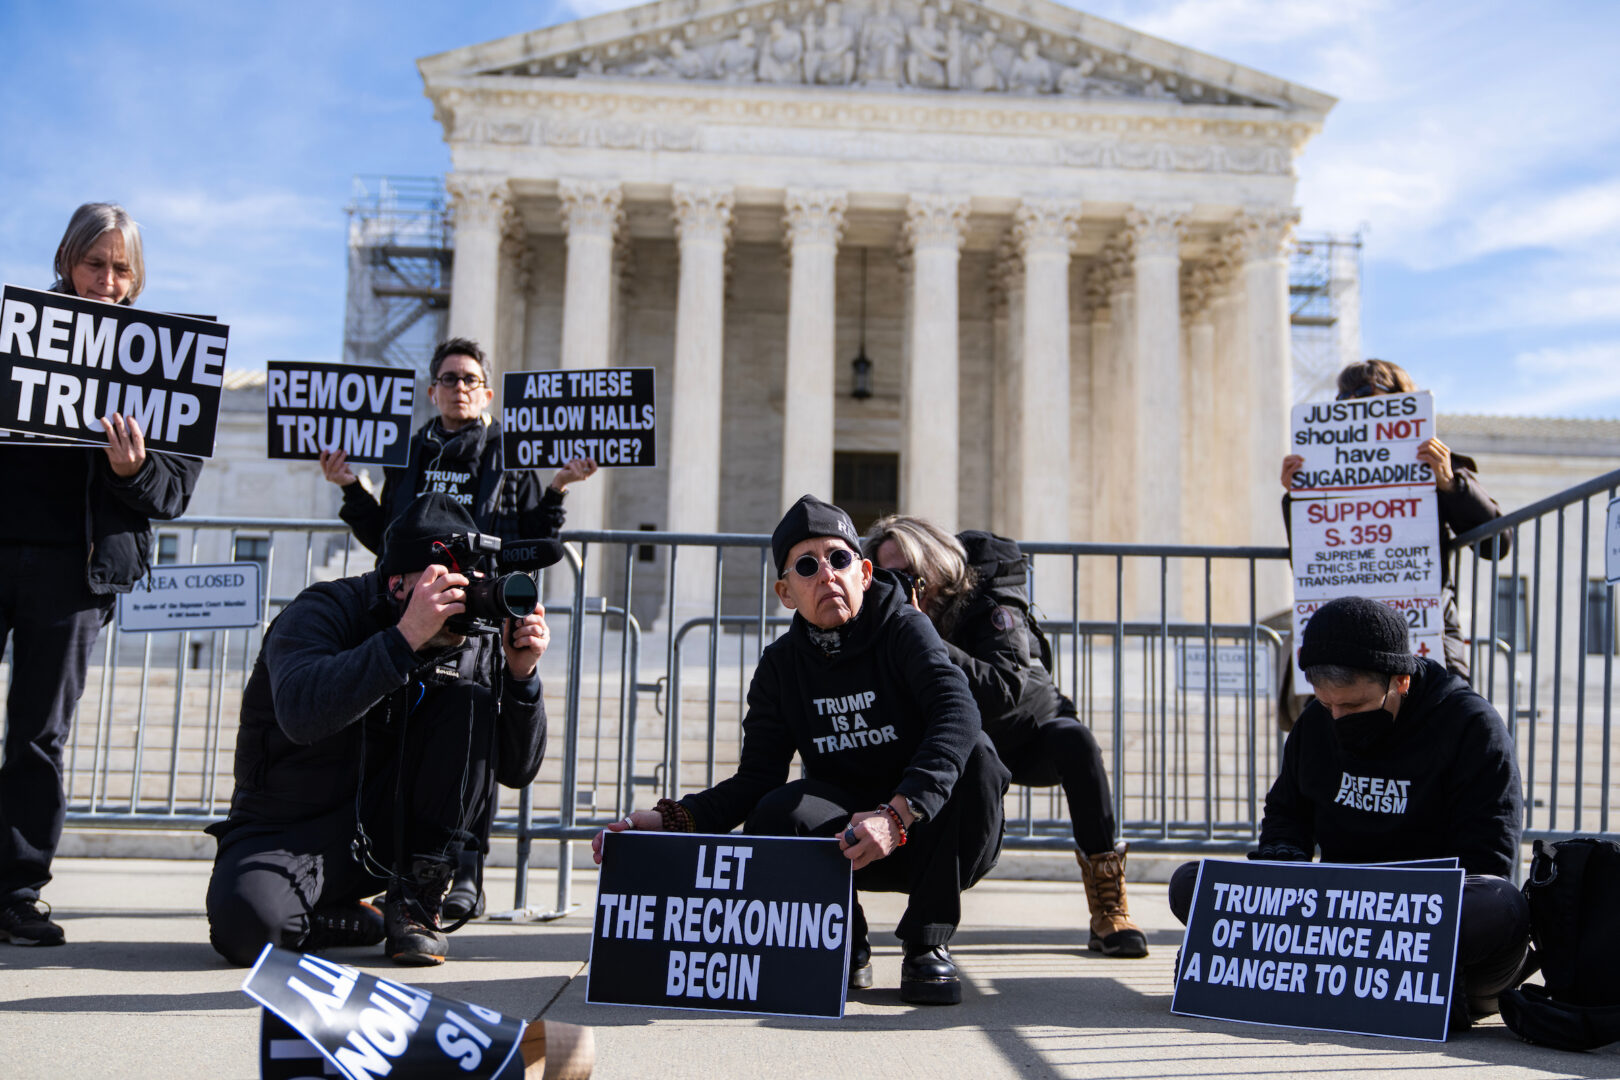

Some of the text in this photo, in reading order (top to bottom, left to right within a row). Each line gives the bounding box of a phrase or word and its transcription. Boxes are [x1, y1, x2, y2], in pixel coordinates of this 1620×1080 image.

[0, 299, 227, 387] REMOVE
[268, 369, 415, 416] REMOVE
[523, 371, 633, 399] ARE THESE
[11, 366, 200, 443] TRUMP
[1303, 397, 1418, 424] JUSTICES
[503, 404, 655, 433] HOLLOW HALLS
[1295, 418, 1427, 445] should NOT
[277, 415, 398, 459] TRUMP
[517, 438, 642, 466] OF JUSTICE?
[1335, 446, 1390, 465] have
[424, 470, 471, 483] TRUMP
[433, 482, 458, 494] IS A
[1291, 463, 1432, 489] SUGARDADDIES
[1307, 498, 1422, 524] SUPPORT
[1325, 524, 1392, 547] S. 359
[1315, 546, 1430, 562] SUPREME COURT
[1359, 560, 1419, 573] RECUSAL
[184, 574, 245, 589] CLOSED
[1297, 570, 1431, 587] TRANSPARENCY ACT
[1383, 598, 1440, 611] ENATOR
[813, 690, 876, 716] TRUMP
[831, 713, 868, 732] IS A
[813, 724, 898, 754] TRAITOR
[1341, 771, 1411, 797] DEFEAT
[1334, 788, 1408, 814] FASCISM
[695, 844, 753, 891] LET
[1213, 882, 1443, 925] TRUMP'S THREATS
[600, 893, 844, 950] THE RECKONING
[1212, 918, 1431, 963] OF VIOLENCE ARE
[666, 950, 761, 1001] BEGIN
[1183, 952, 1445, 1005] A DANGER TO US ALL
